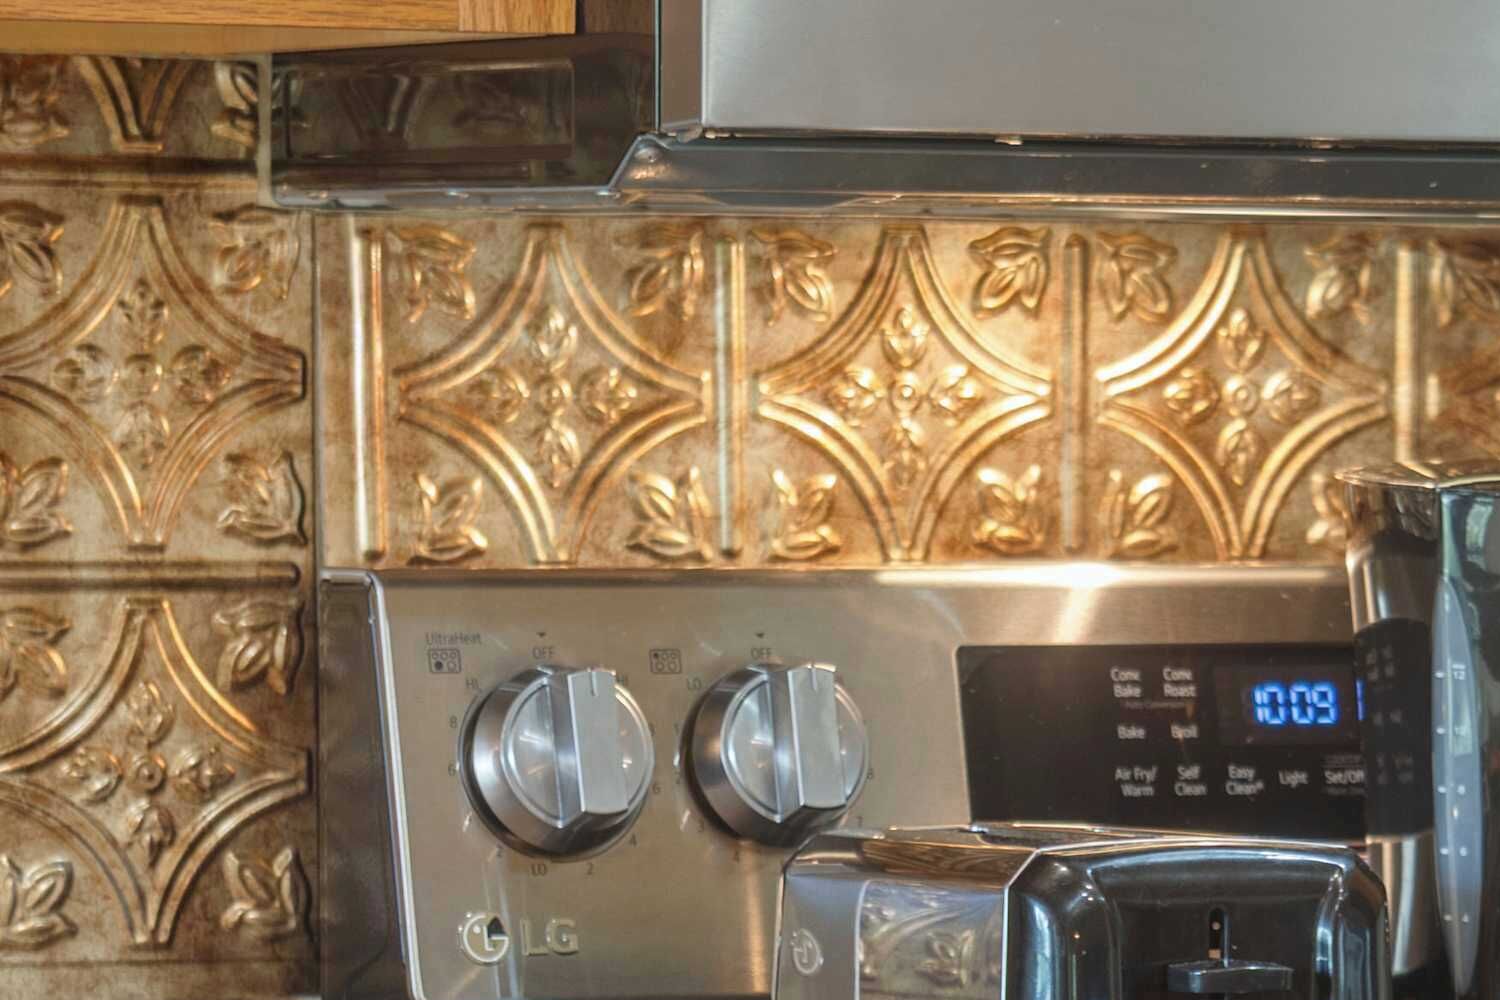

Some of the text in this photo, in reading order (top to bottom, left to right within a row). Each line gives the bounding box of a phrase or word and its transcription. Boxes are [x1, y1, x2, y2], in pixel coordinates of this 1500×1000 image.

[426, 632, 483, 646] UltraHeat
[532, 646, 555, 660] OFF
[751, 647, 772, 660] OFF
[1110, 666, 1141, 682] Conv
[1163, 666, 1193, 682] Conv
[1113, 683, 1142, 698] Bake
[1163, 683, 1197, 698] Roast
[1117, 724, 1146, 739] Bake
[1170, 724, 1198, 739] Broil
[1115, 767, 1132, 781] Air
[1176, 765, 1200, 780] Self
[1227, 764, 1255, 781] Easy
[1278, 769, 1309, 788] Light
[1120, 783, 1154, 797] Warm
[1174, 782, 1207, 796] Clean
[519, 917, 580, 957] LG
